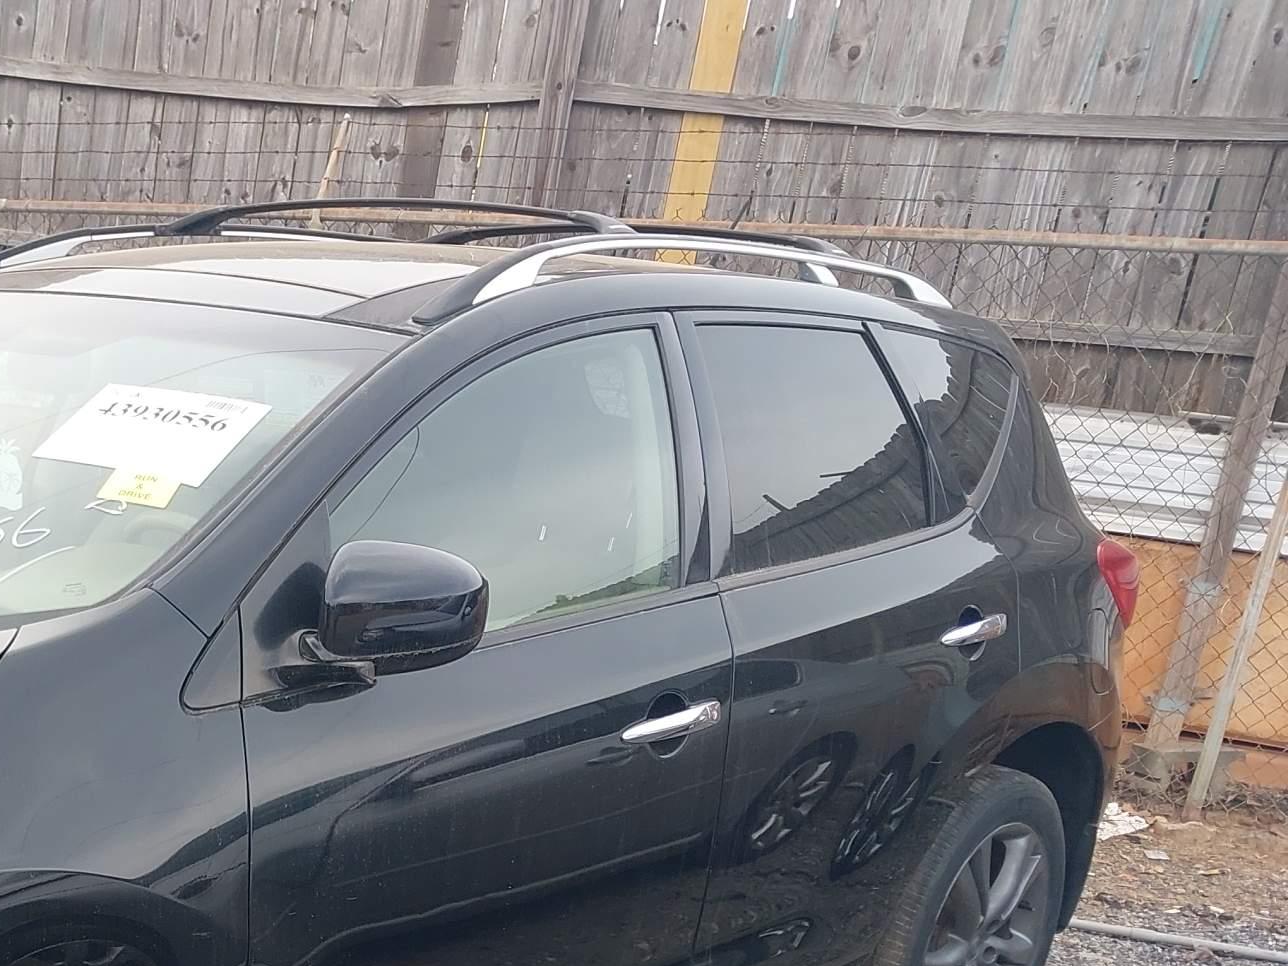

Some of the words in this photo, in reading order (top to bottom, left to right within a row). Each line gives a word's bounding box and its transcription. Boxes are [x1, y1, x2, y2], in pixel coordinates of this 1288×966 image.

[98, 401, 231, 433] 43930556
[133, 473, 160, 483] RUN
[117, 489, 153, 501] DRIVE
